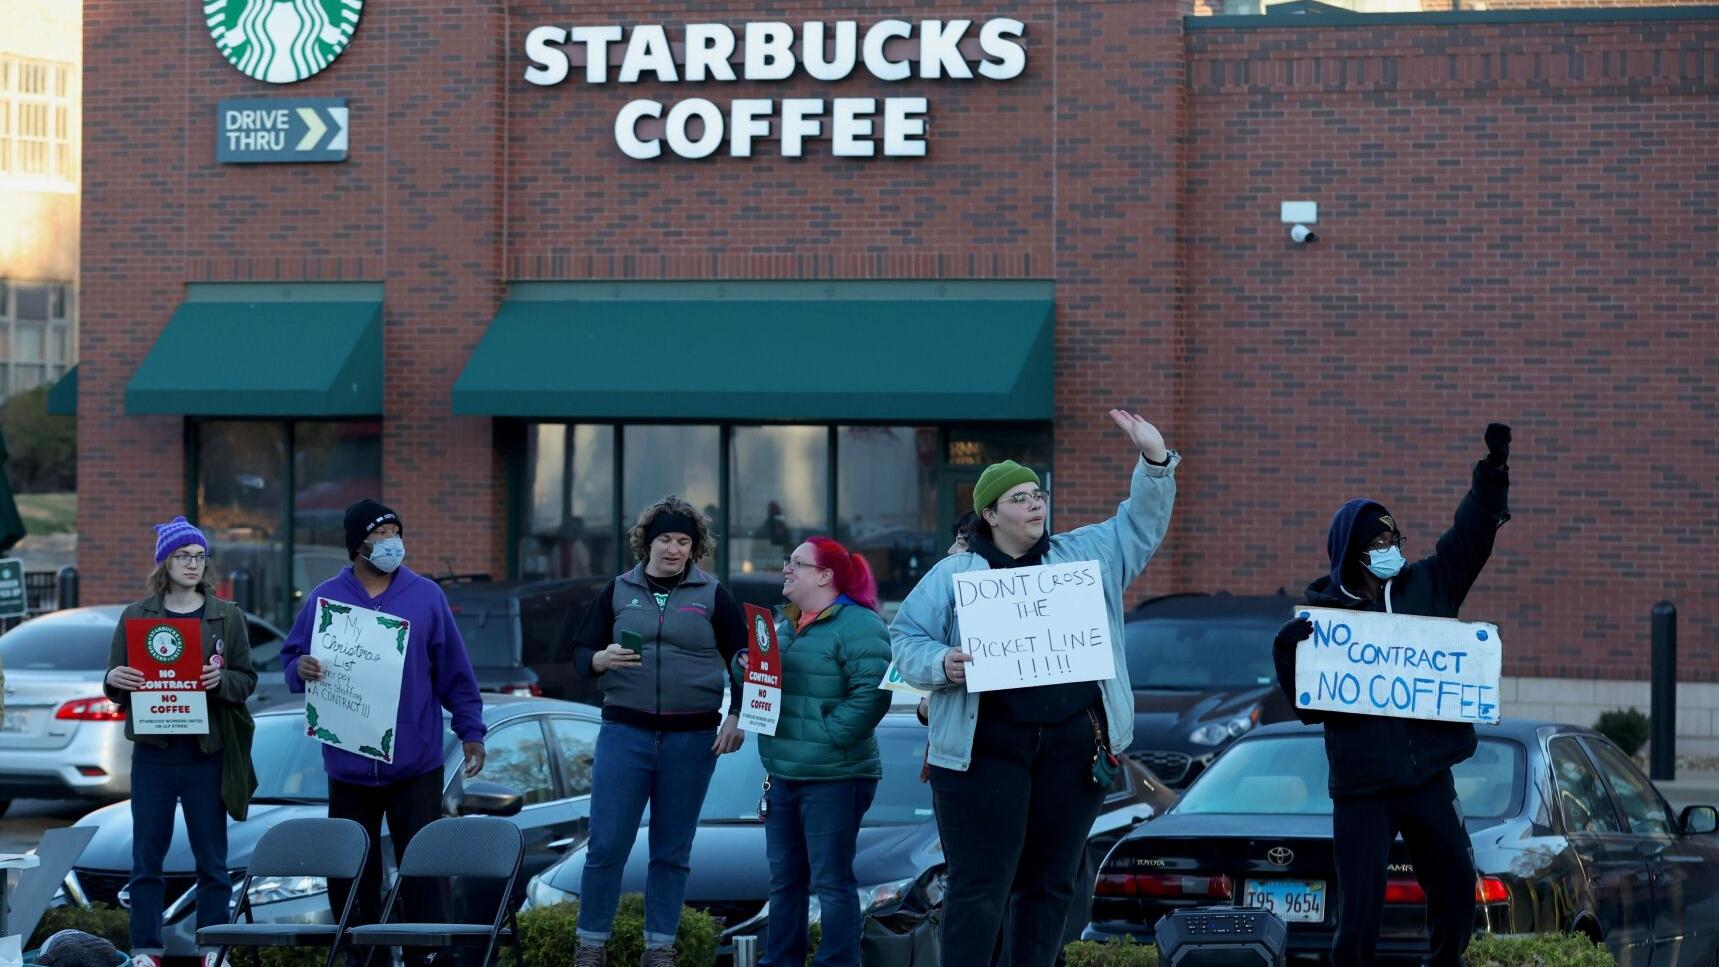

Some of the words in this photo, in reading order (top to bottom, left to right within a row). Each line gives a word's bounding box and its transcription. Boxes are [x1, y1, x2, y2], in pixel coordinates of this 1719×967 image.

[524, 18, 1027, 86] STARBUCKS
[225, 109, 290, 130] DRIVE
[614, 97, 928, 160] COFFEE
[226, 131, 285, 151] THRU
[1011, 598, 1051, 619] THE
[344, 614, 364, 643] My
[968, 636, 1036, 667] PICKET
[1047, 628, 1103, 652] LINE
[1313, 619, 1352, 649] NO
[1347, 642, 1468, 674] CONTRACT
[333, 654, 356, 673] List
[760, 661, 769, 671] NO
[159, 669, 176, 679] NO
[749, 671, 778, 685] CONTRACT
[161, 694, 178, 703] NO
[312, 685, 319, 697] A
[758, 688, 767, 698] NO
[1317, 671, 1361, 705] NO
[1369, 674, 1496, 720] COFFEE
[150, 705, 191, 714] COFFEE
[750, 699, 772, 712] COFFEE
[1136, 859, 1165, 867] TOYOTA
[1386, 863, 1414, 872] AMR
[1248, 892, 1274, 911] T95
[1285, 892, 1320, 913] 9654
